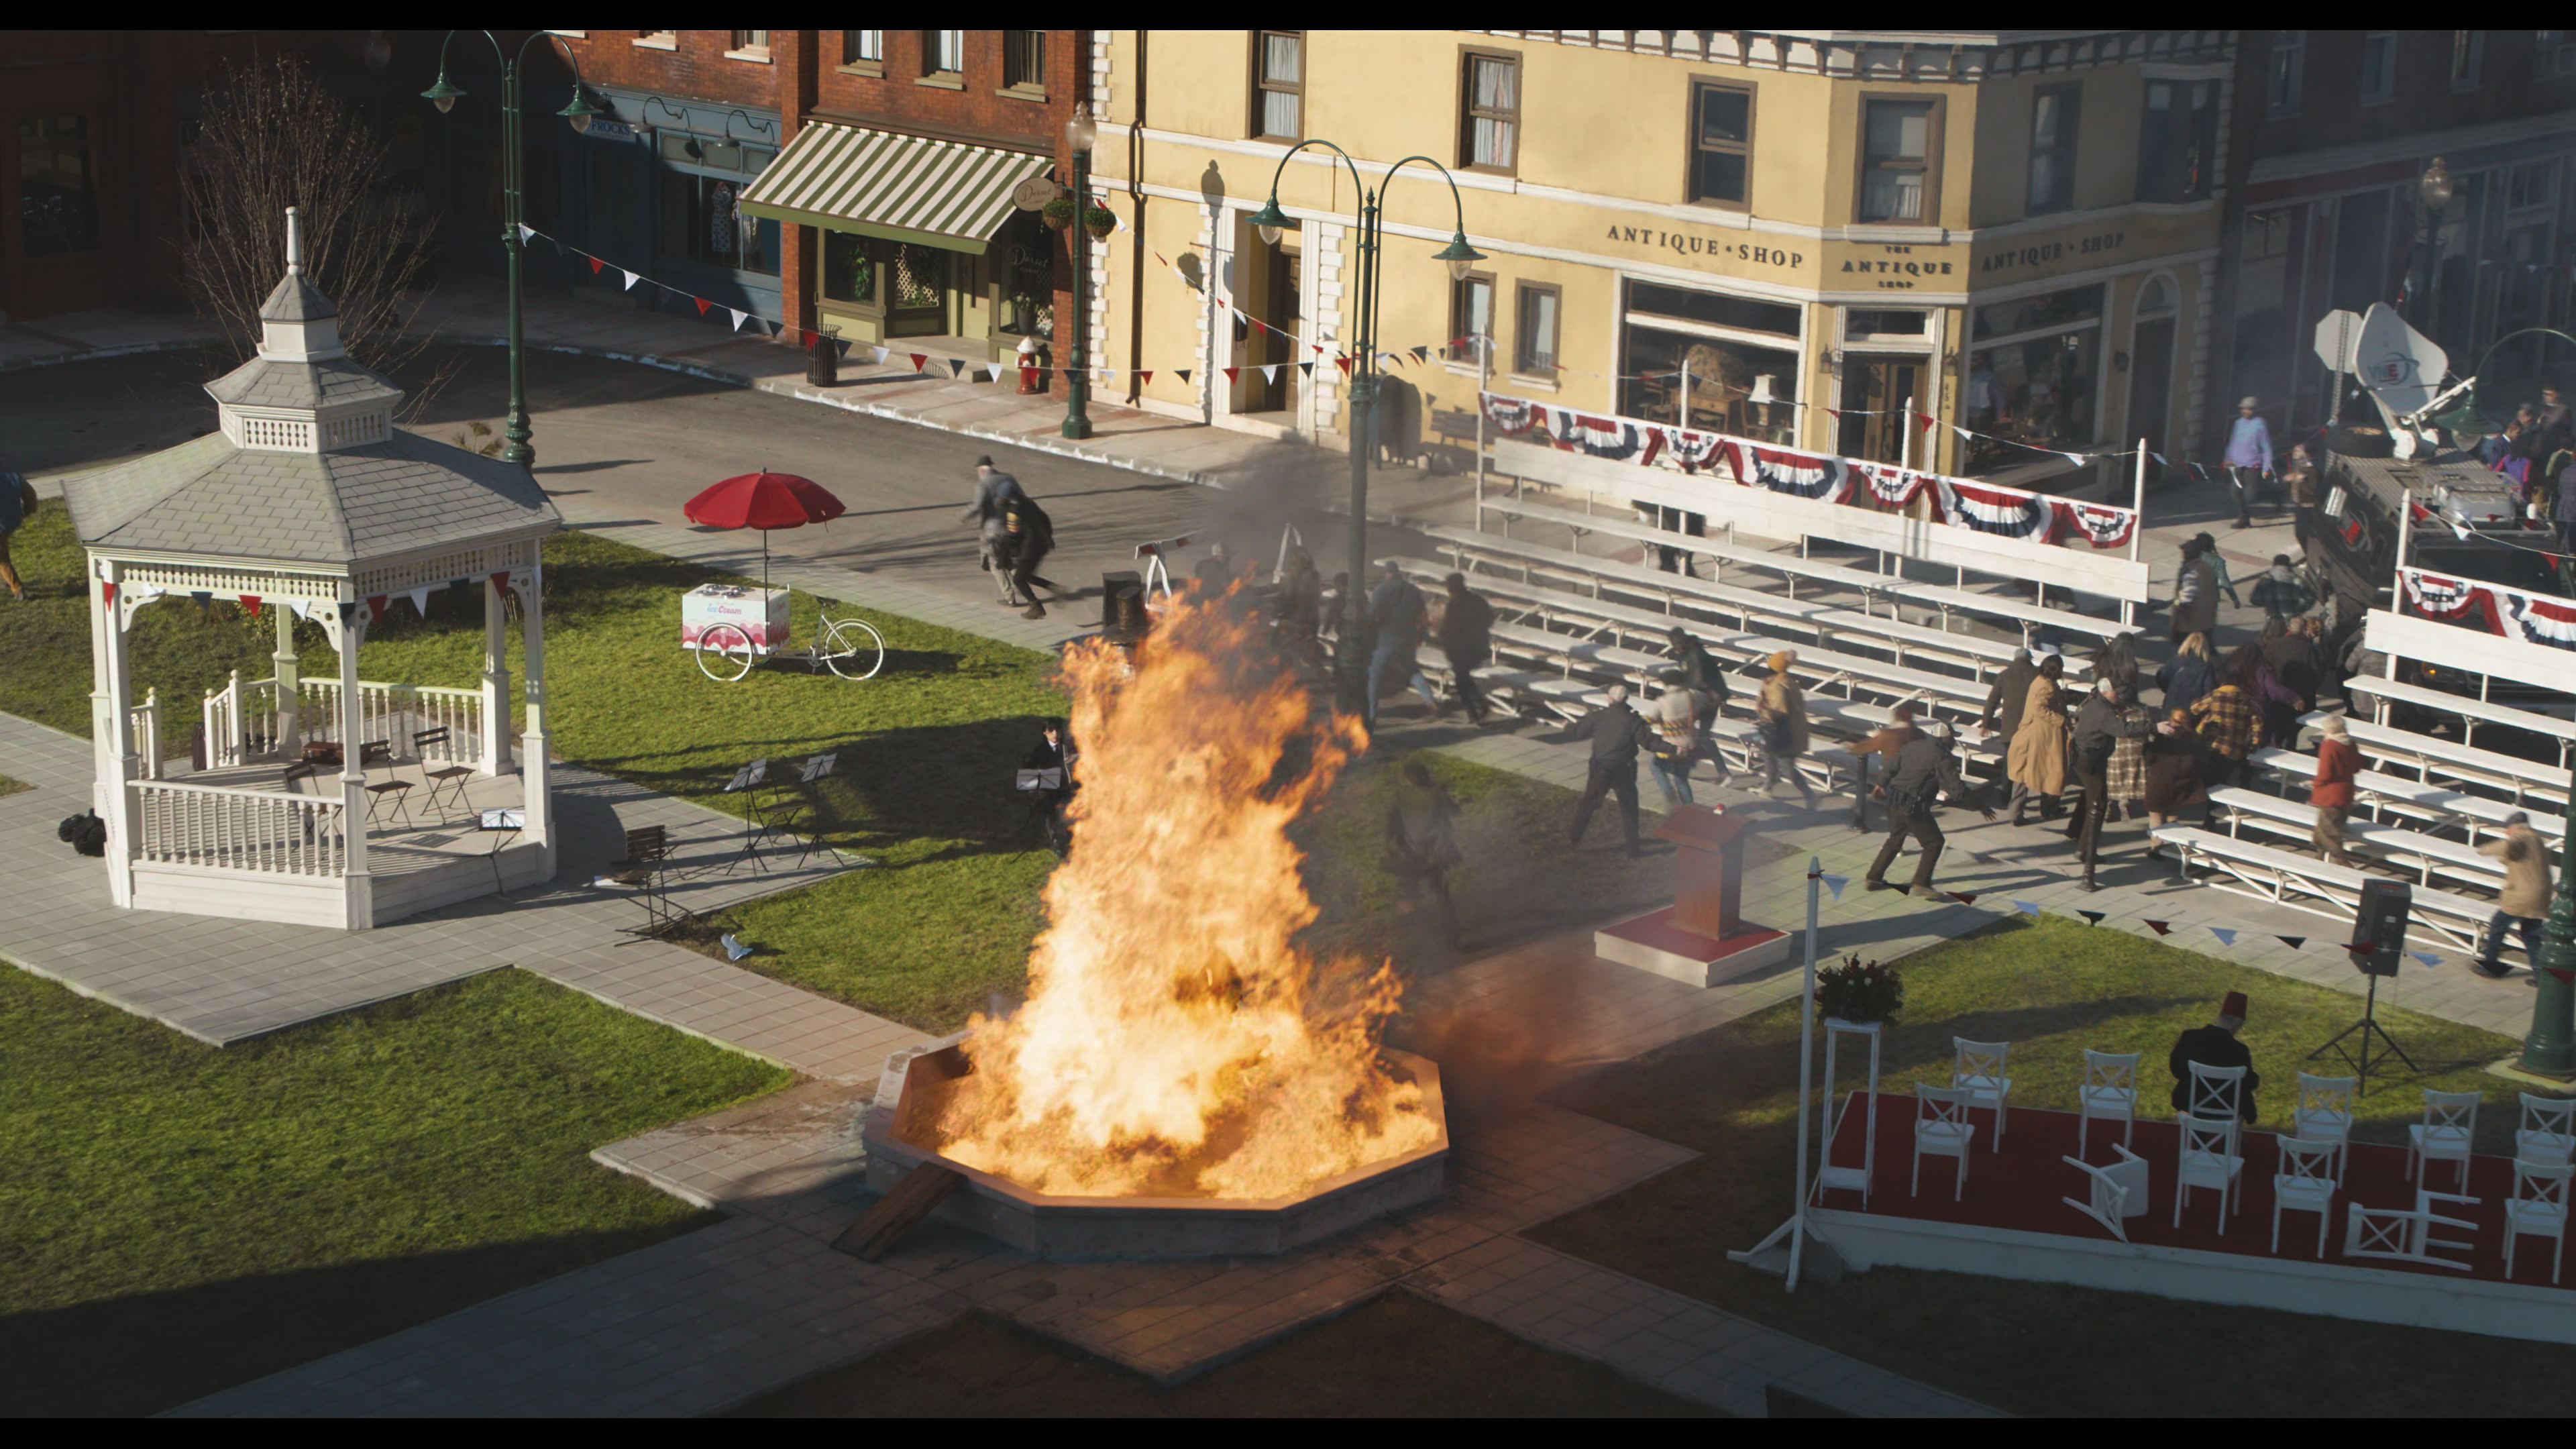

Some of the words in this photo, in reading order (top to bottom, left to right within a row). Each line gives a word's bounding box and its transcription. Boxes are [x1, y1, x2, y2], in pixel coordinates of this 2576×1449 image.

[592, 120, 629, 135] FROCKS
[1607, 225, 1718, 255] ANTIQUE
[1739, 244, 1803, 268] SHOP
[1885, 246, 1911, 254] THE
[1982, 243, 2062, 272] ANTIQUE
[2081, 233, 2125, 254] SHOP
[1841, 260, 1953, 277] ANTIQUE
[718, 605, 741, 614] Cream
